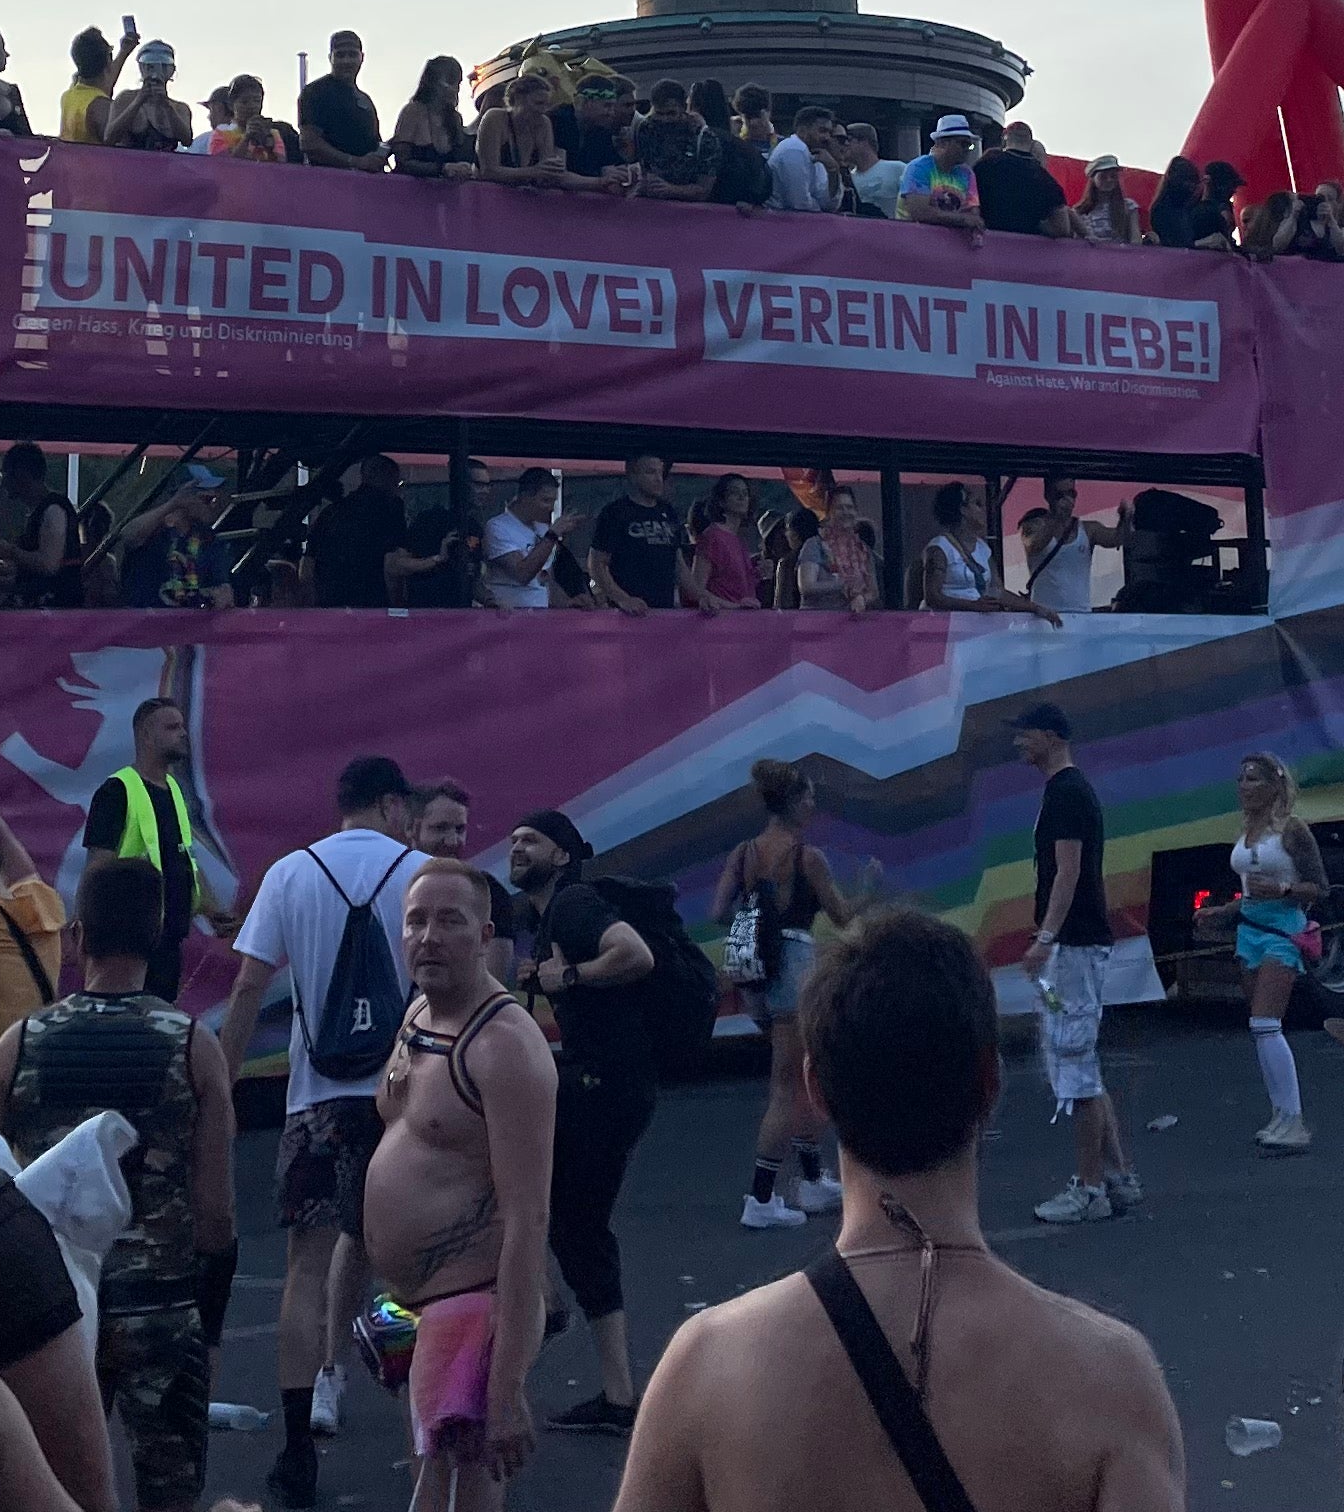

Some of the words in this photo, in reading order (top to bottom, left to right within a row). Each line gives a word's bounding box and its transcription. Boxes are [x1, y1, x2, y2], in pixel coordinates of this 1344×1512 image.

[50, 233, 345, 315] UNITED
[371, 255, 442, 323] IN
[464, 263, 664, 336] LOVE!
[12, 313, 72, 333] Gegen
[78, 315, 124, 336] Hass,
[128, 318, 175, 339] Krieg
[180, 322, 213, 339] und
[218, 322, 353, 350] Diskriminierung
[711, 279, 968, 355] VEREINT
[985, 304, 1039, 362] IN
[1056, 310, 1211, 374] LIEBE!
[986, 370, 1032, 388] Against
[1035, 372, 1068, 391] Hate,
[1071, 377, 1097, 391] War
[1098, 379, 1120, 393] and
